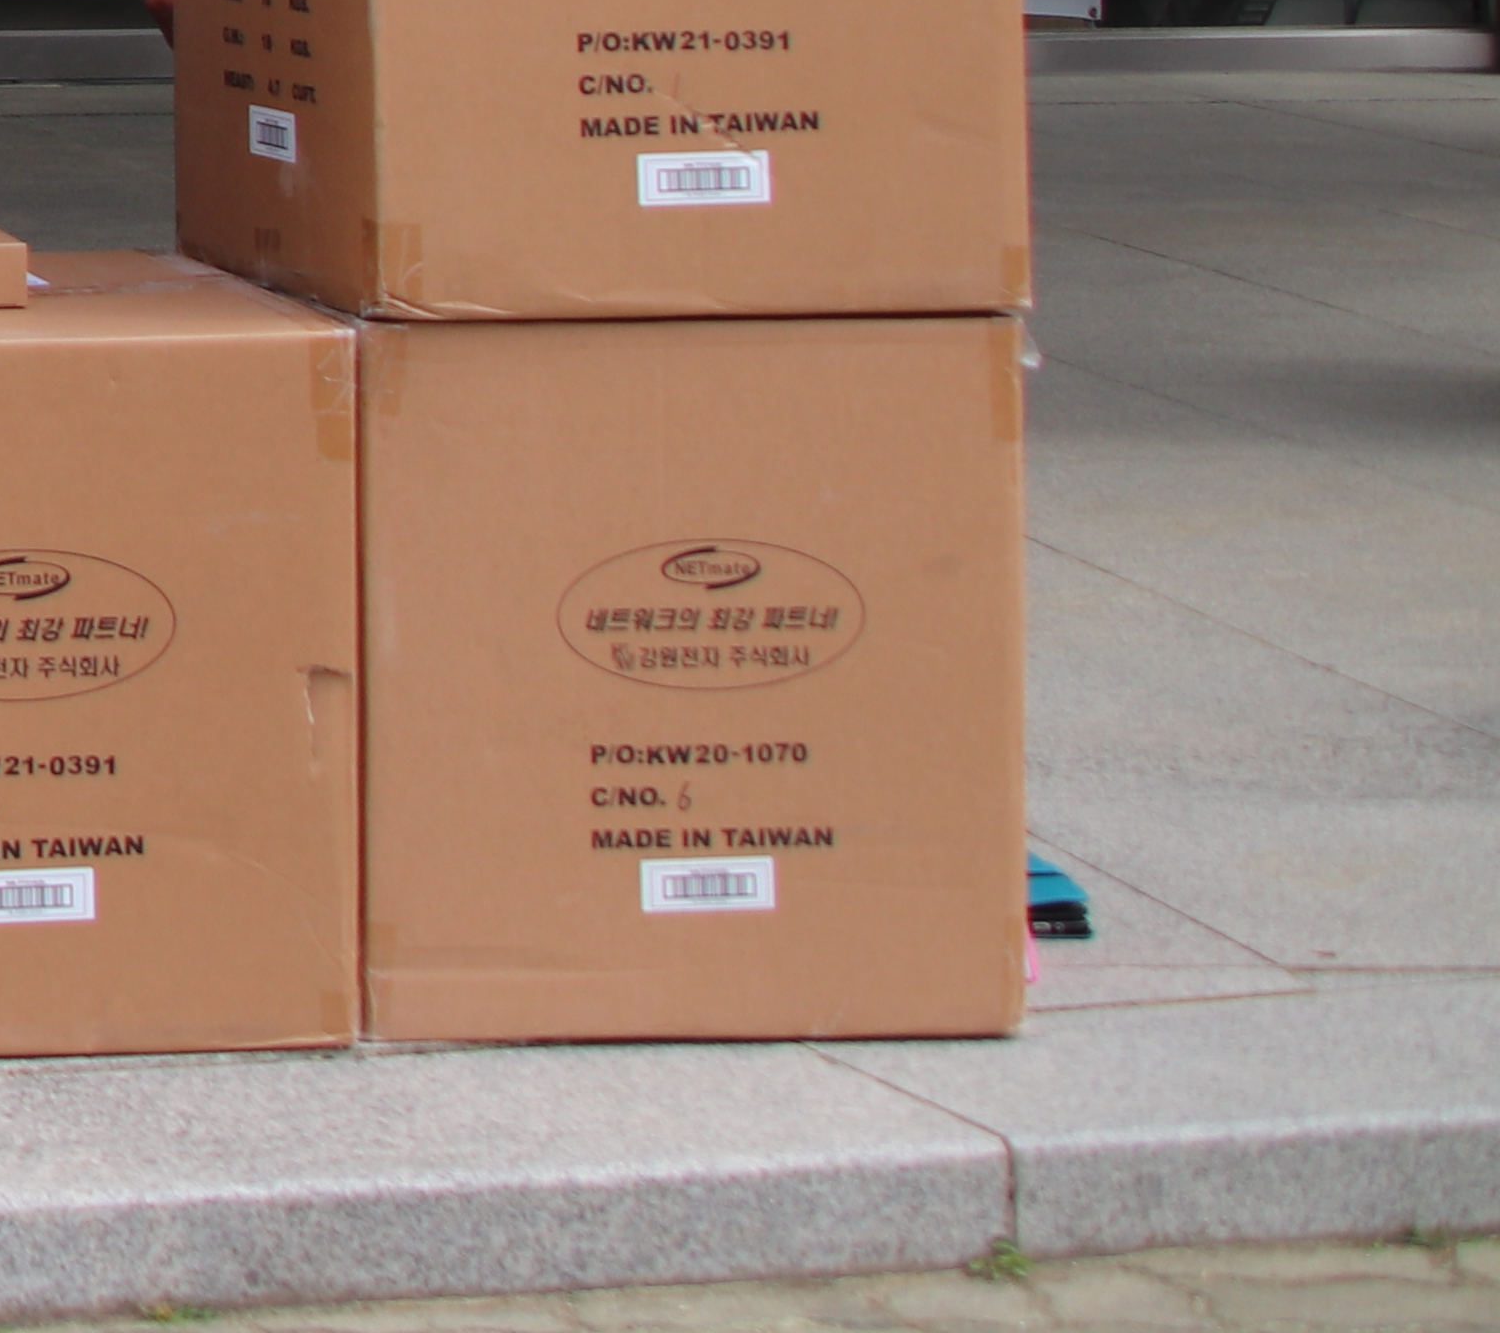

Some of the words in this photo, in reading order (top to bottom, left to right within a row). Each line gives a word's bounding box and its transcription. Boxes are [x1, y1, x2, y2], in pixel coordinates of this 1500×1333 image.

[577, 30, 790, 53] P/O:KW21-0391
[578, 73, 652, 96] C/NO.
[580, 116, 660, 138] MADE
[670, 115, 699, 135] IN
[707, 111, 819, 133] TAIWAN
[16, 617, 65, 643] 최강
[70, 616, 149, 641] 파트너!
[38, 655, 120, 679] 주식회사
[591, 743, 808, 766] P/O:KW20-1070
[591, 787, 666, 808] C/NO.
[678, 781, 692, 812] 6
[31, 835, 144, 859] TAIWAN
